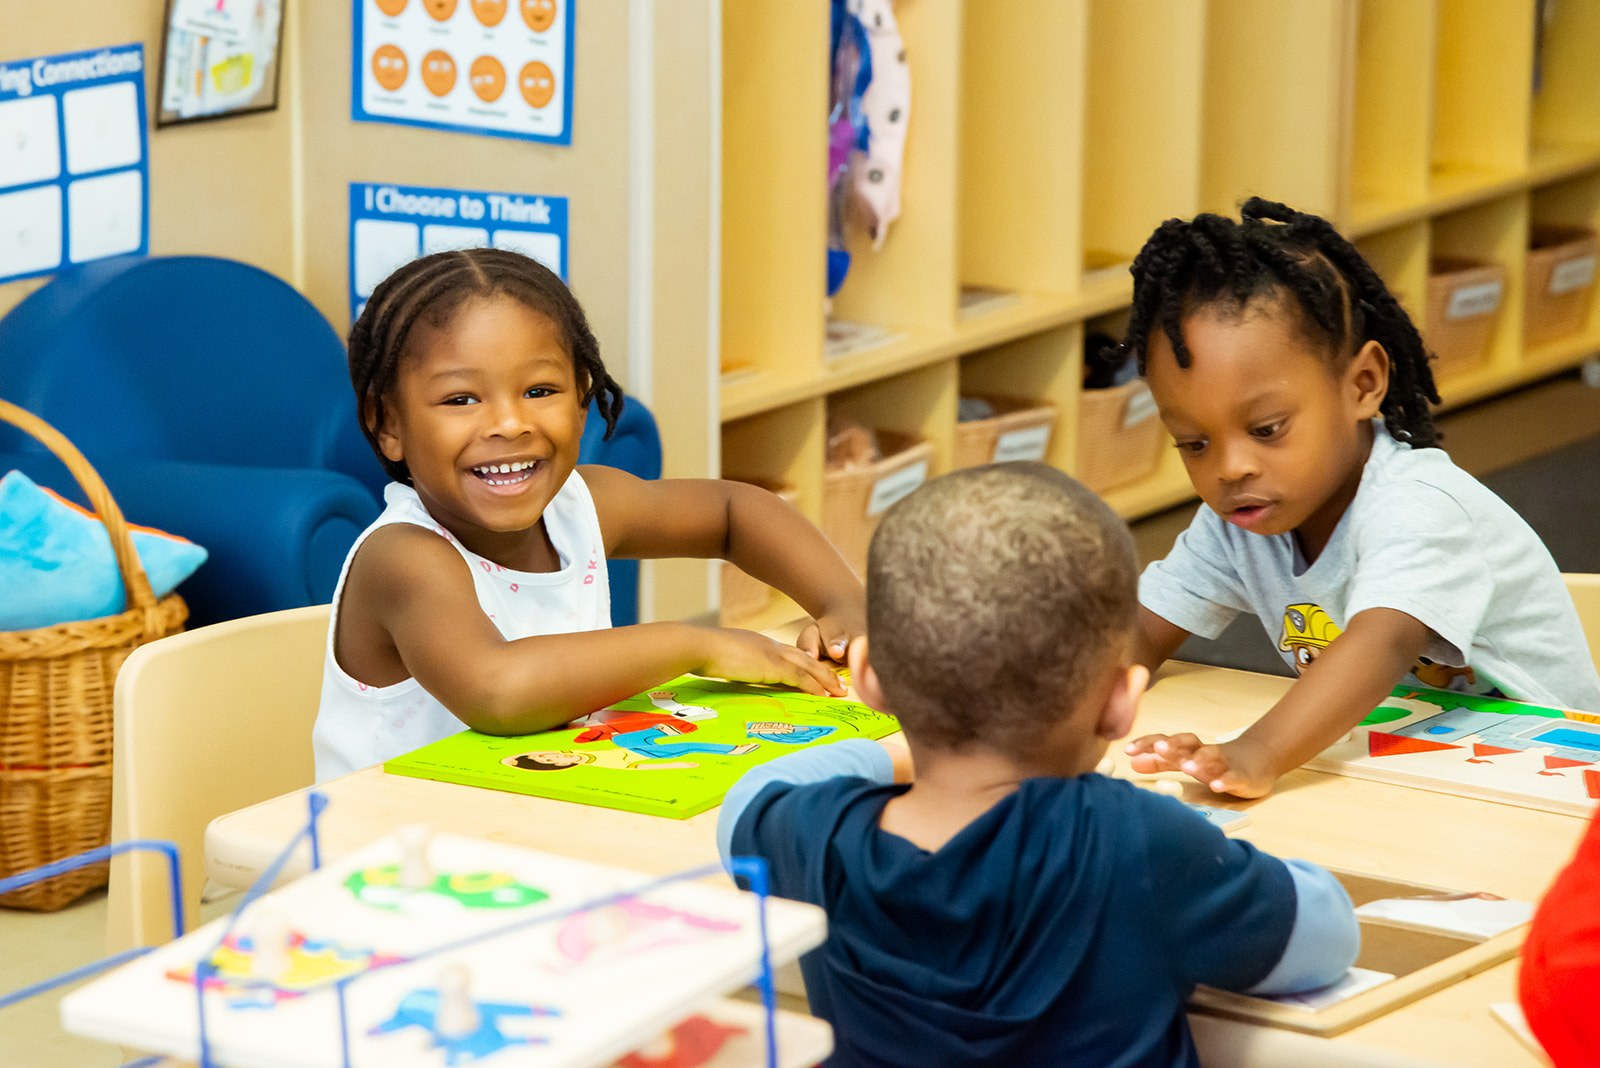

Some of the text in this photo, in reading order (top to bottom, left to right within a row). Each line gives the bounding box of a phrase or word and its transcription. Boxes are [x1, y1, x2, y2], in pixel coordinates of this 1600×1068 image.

[0, 50, 142, 97] ing Connections
[364, 186, 551, 225] I Choose to Think
